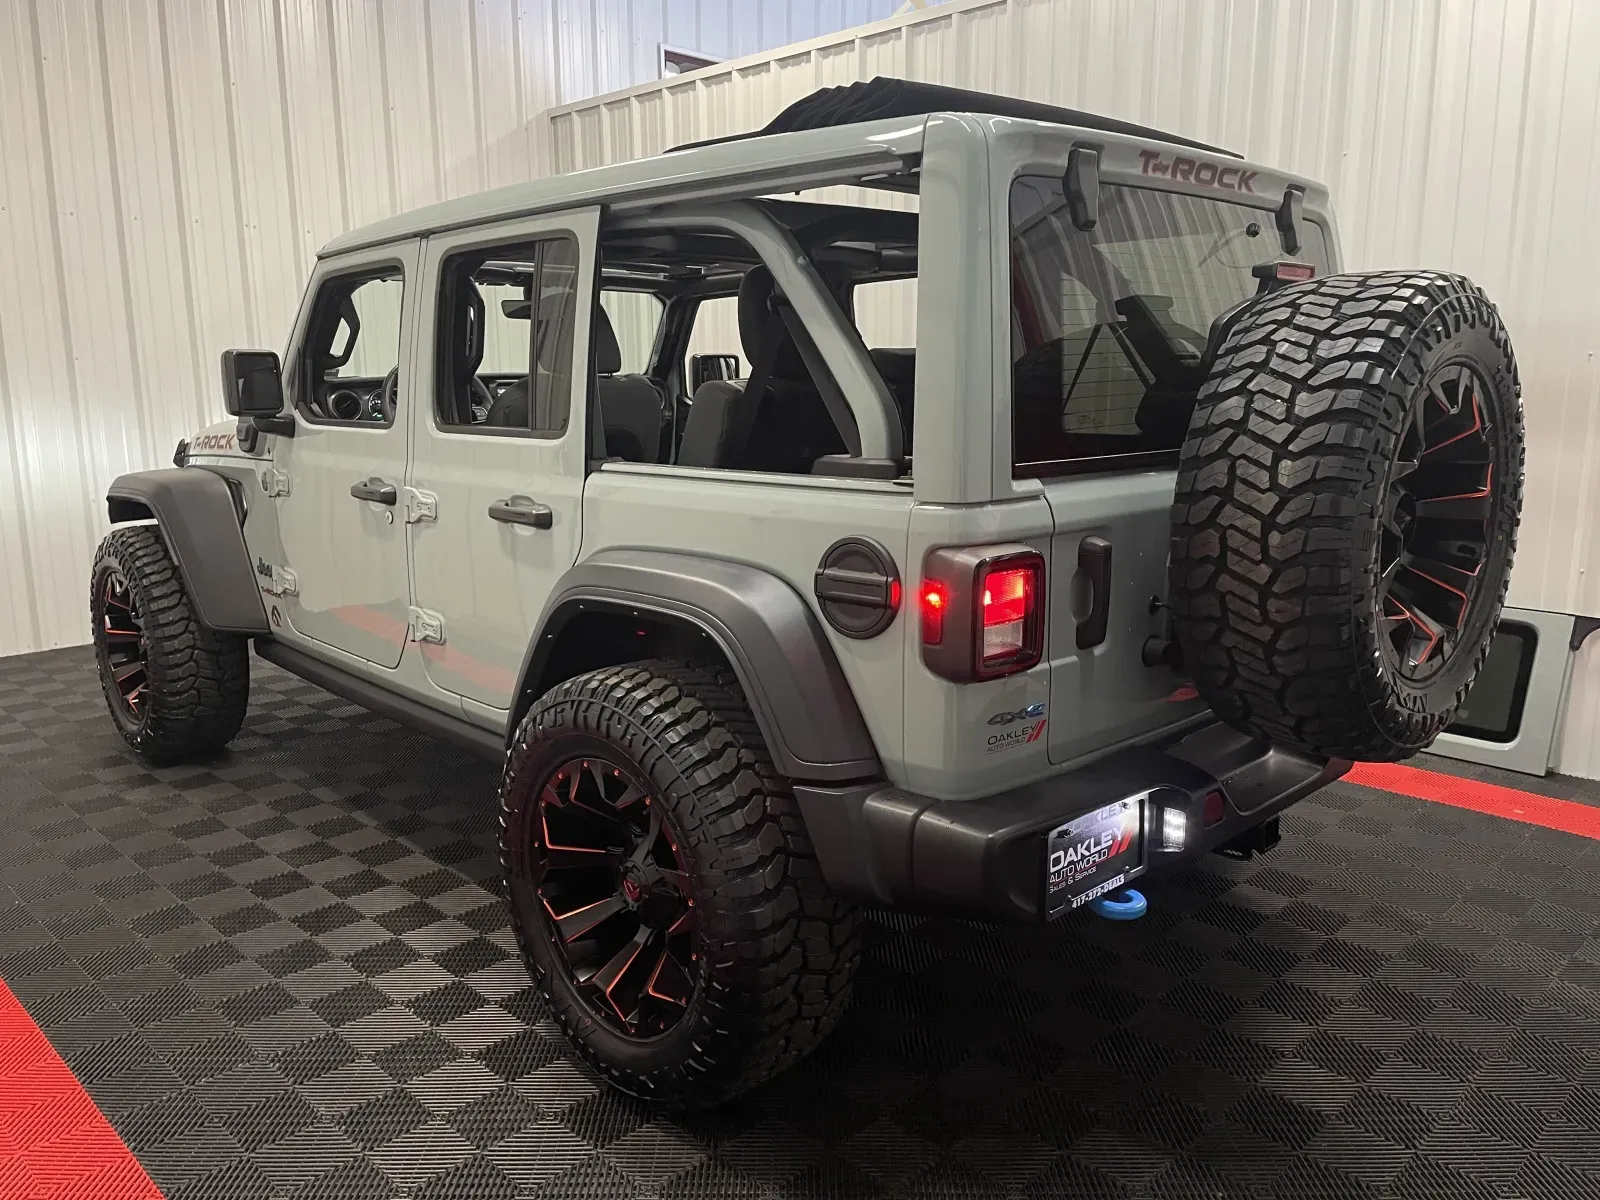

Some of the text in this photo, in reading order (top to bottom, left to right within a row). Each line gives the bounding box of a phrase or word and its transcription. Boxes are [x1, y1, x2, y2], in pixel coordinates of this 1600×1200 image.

[987, 723, 1037, 746] OAKLEY
[987, 737, 1026, 753] AUTO WORLD
[1050, 827, 1125, 873] OAKLEY
[1049, 848, 1108, 883] AUTO WORLD
[1067, 876, 1074, 885] &
[1072, 874, 1125, 909] 417-272-DEALS
